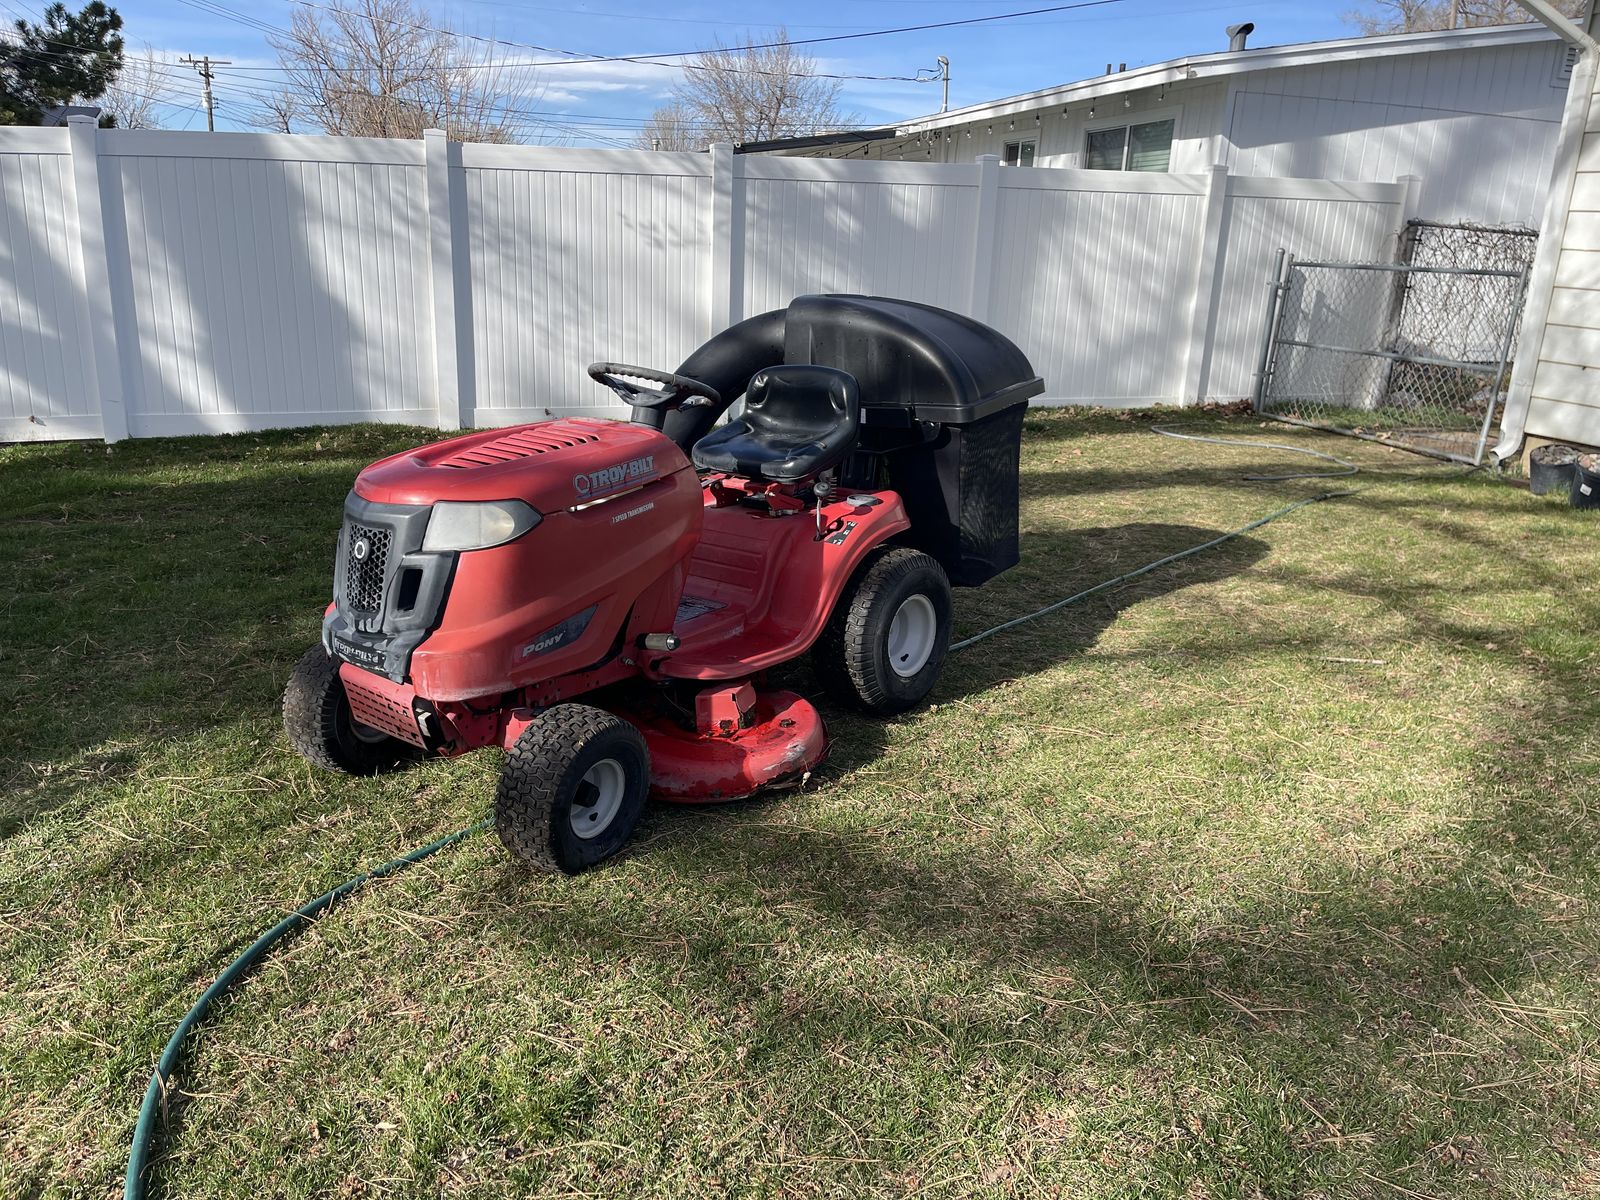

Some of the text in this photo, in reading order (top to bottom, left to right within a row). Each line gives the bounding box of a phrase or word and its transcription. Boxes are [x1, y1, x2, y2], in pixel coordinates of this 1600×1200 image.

[589, 456, 654, 489] TROY-BILT
[615, 512, 628, 523] SPEED
[627, 502, 654, 517] TRANSMISSION
[522, 632, 564, 657] PONY
